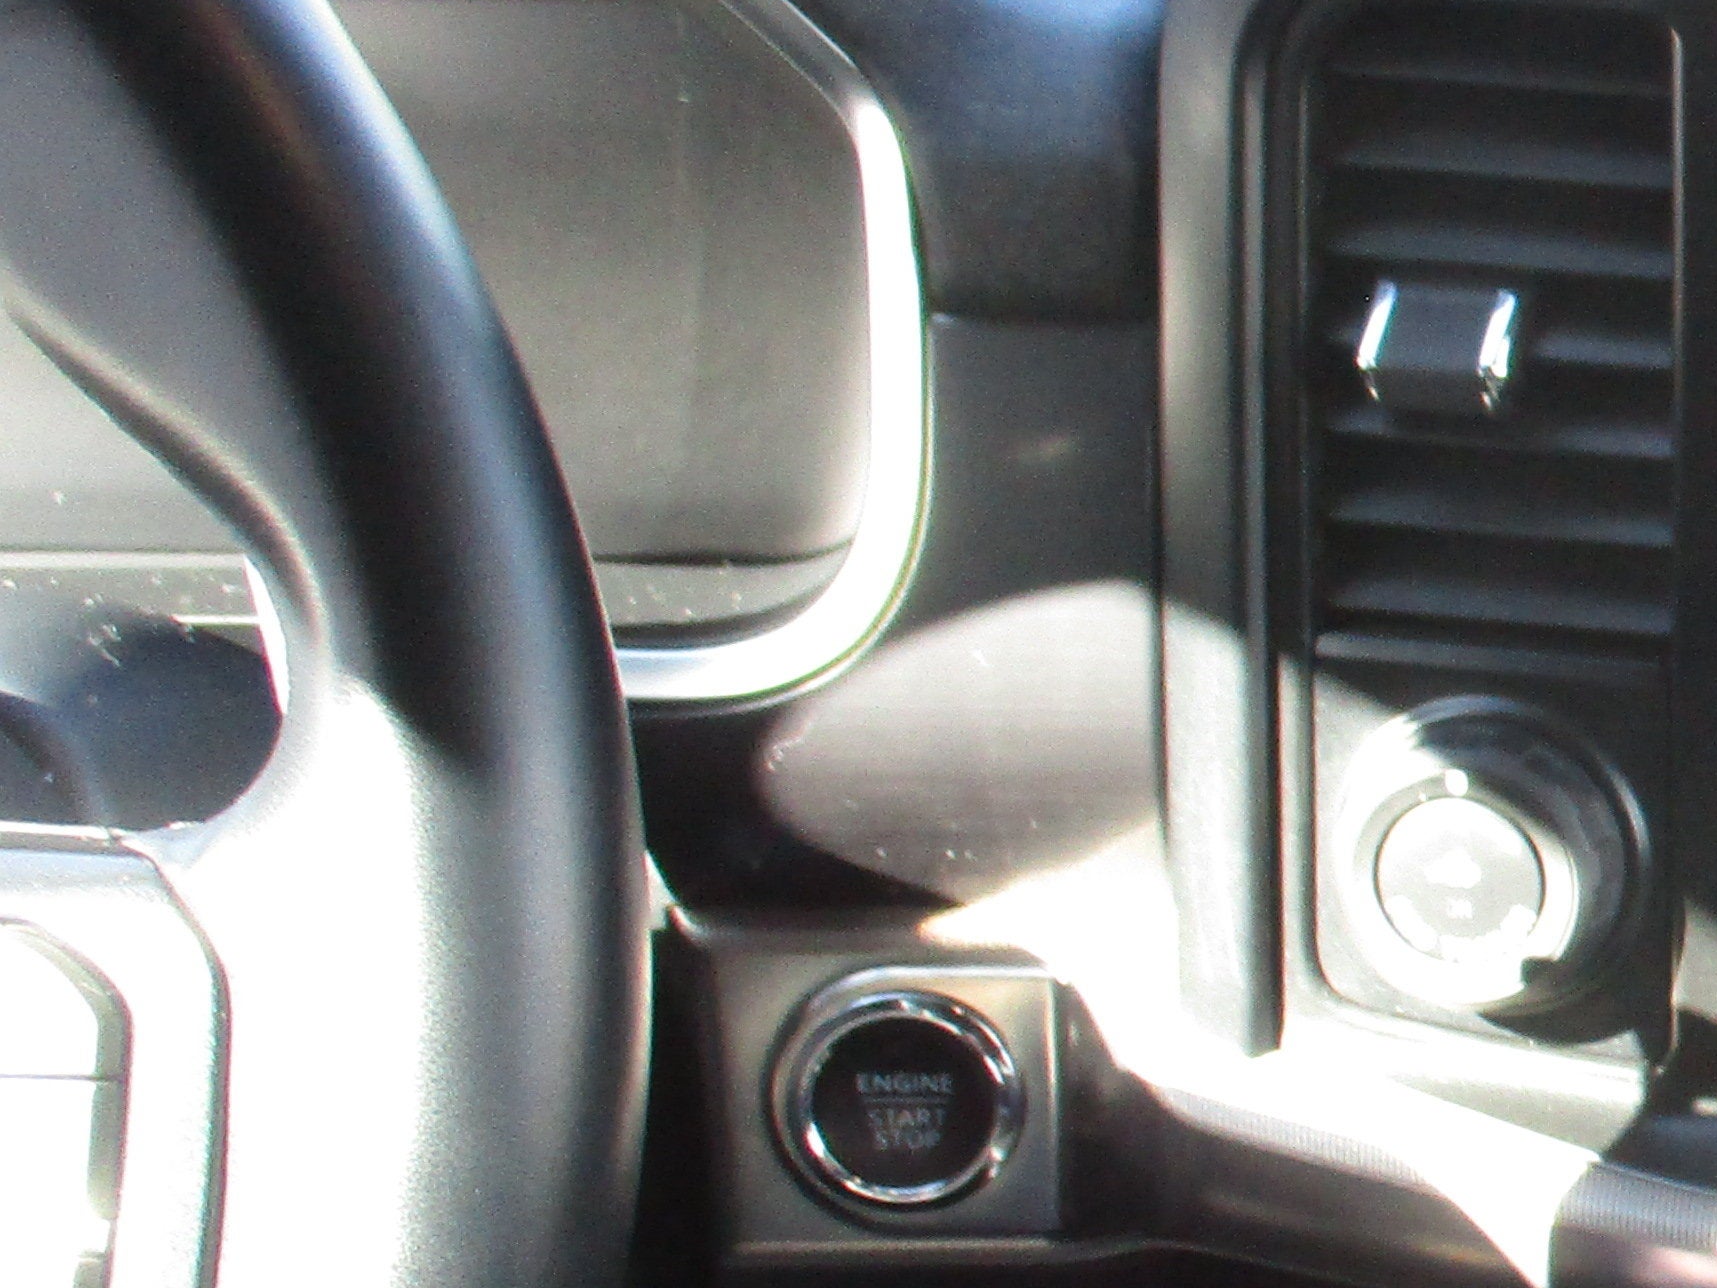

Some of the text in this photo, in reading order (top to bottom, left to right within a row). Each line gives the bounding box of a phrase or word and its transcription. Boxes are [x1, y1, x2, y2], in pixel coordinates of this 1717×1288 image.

[855, 1072, 953, 1095] ENGINE
[868, 1108, 947, 1128] START
[875, 1129, 942, 1150] STOP
